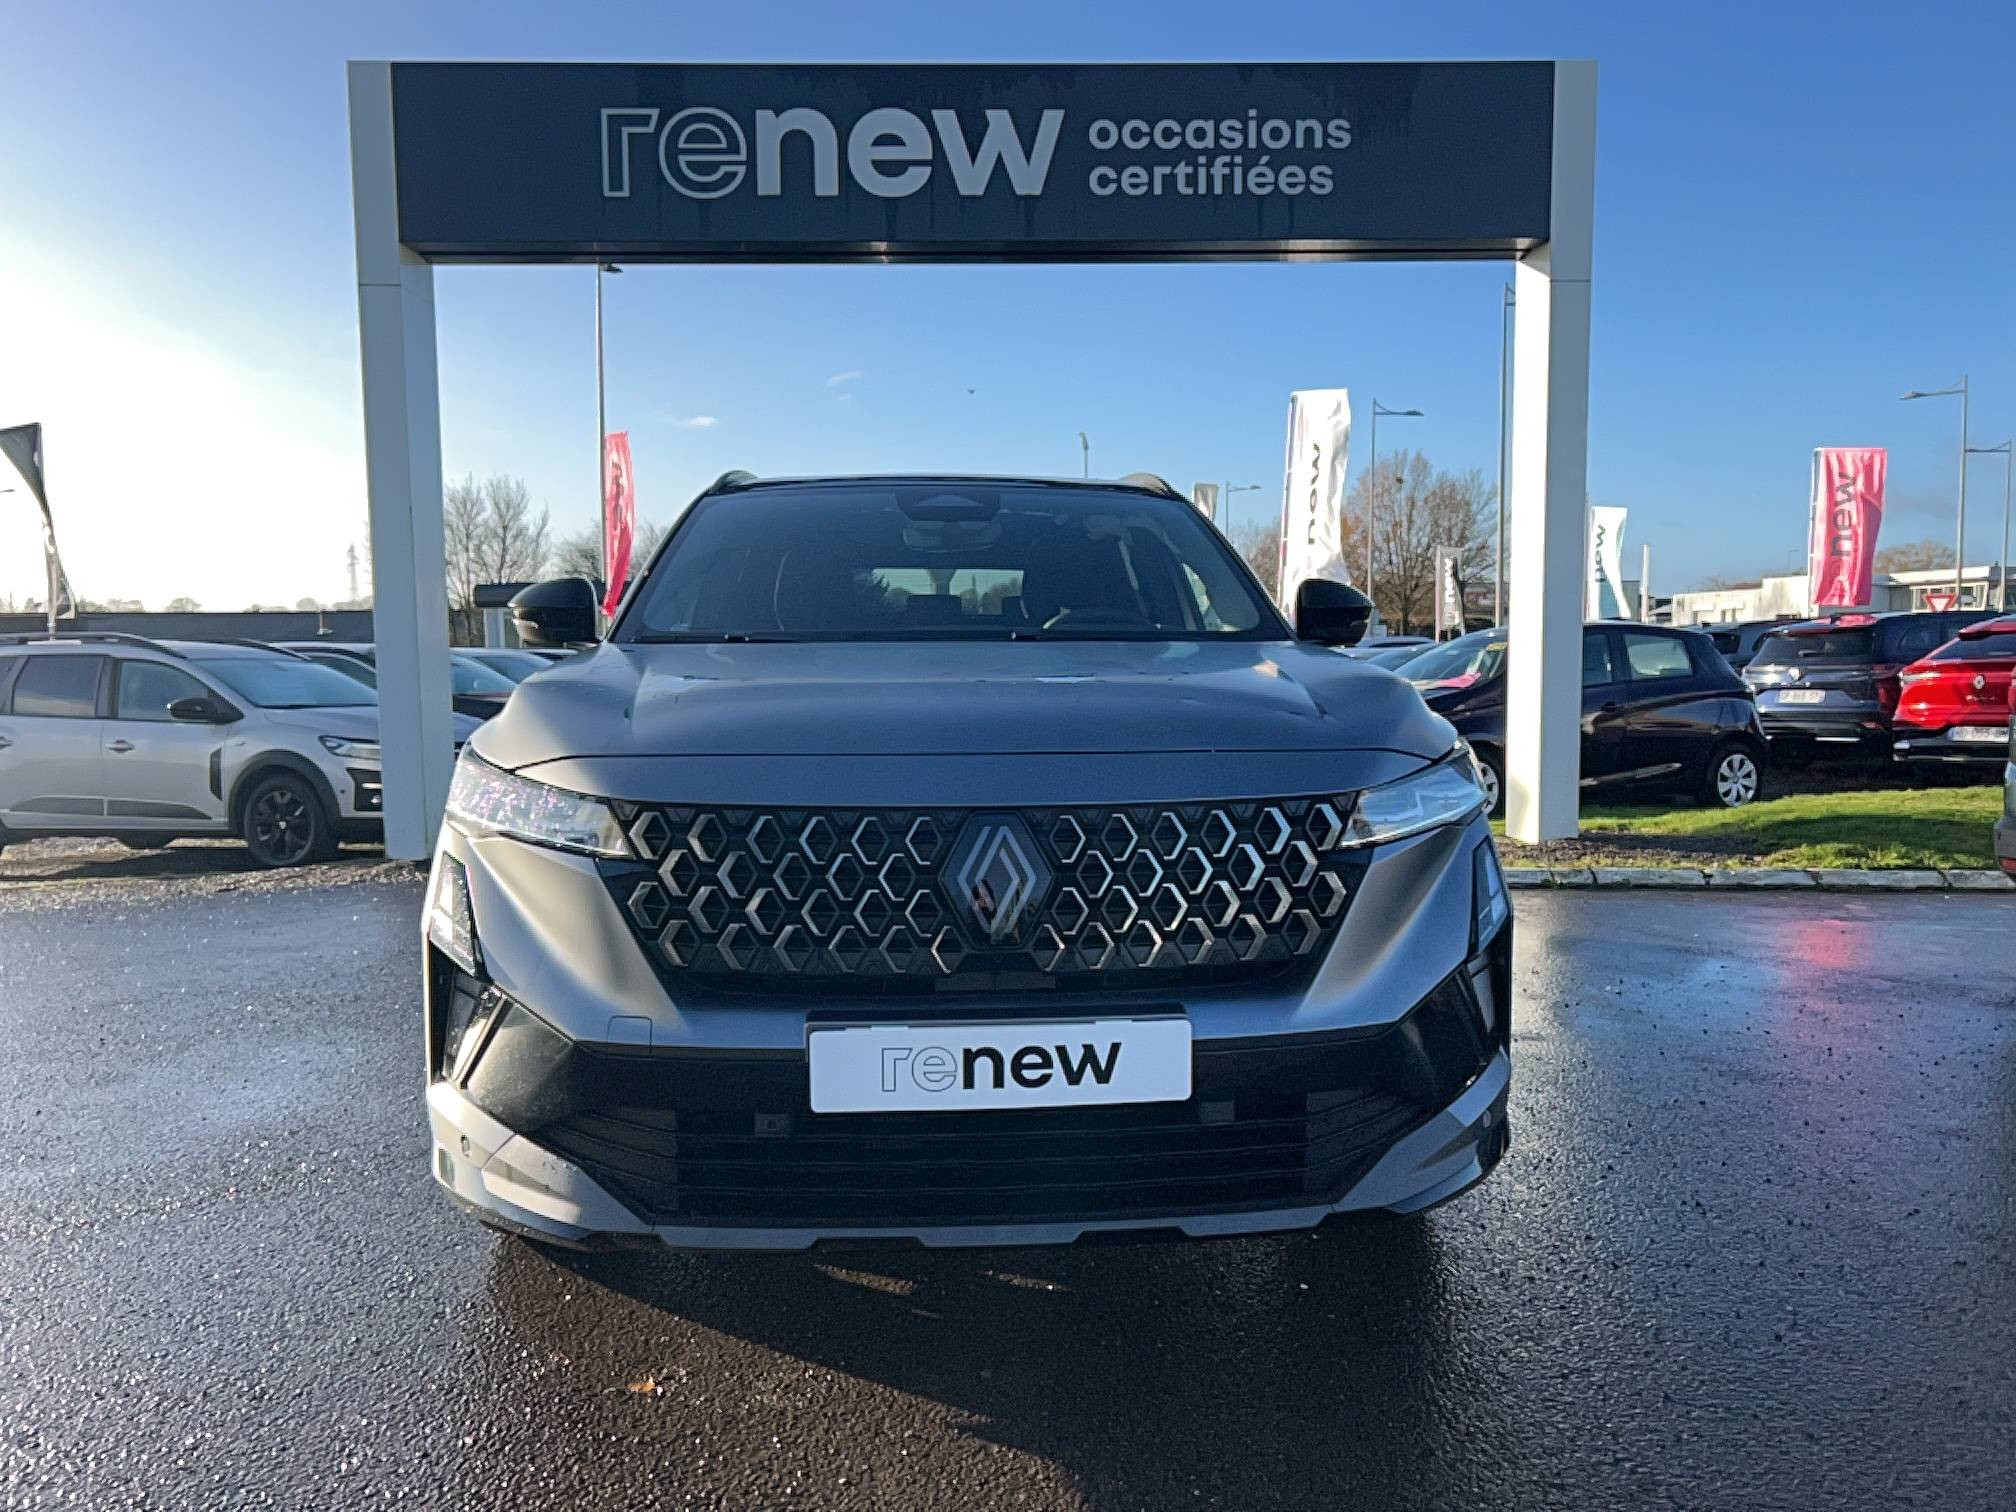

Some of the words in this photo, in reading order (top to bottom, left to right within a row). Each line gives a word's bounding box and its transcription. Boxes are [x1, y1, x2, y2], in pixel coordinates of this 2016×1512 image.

[600, 106, 1066, 200] renew
[1087, 108, 1352, 151] occasions
[1087, 155, 1335, 198] certifiées
[880, 1041, 1123, 1093] renew
